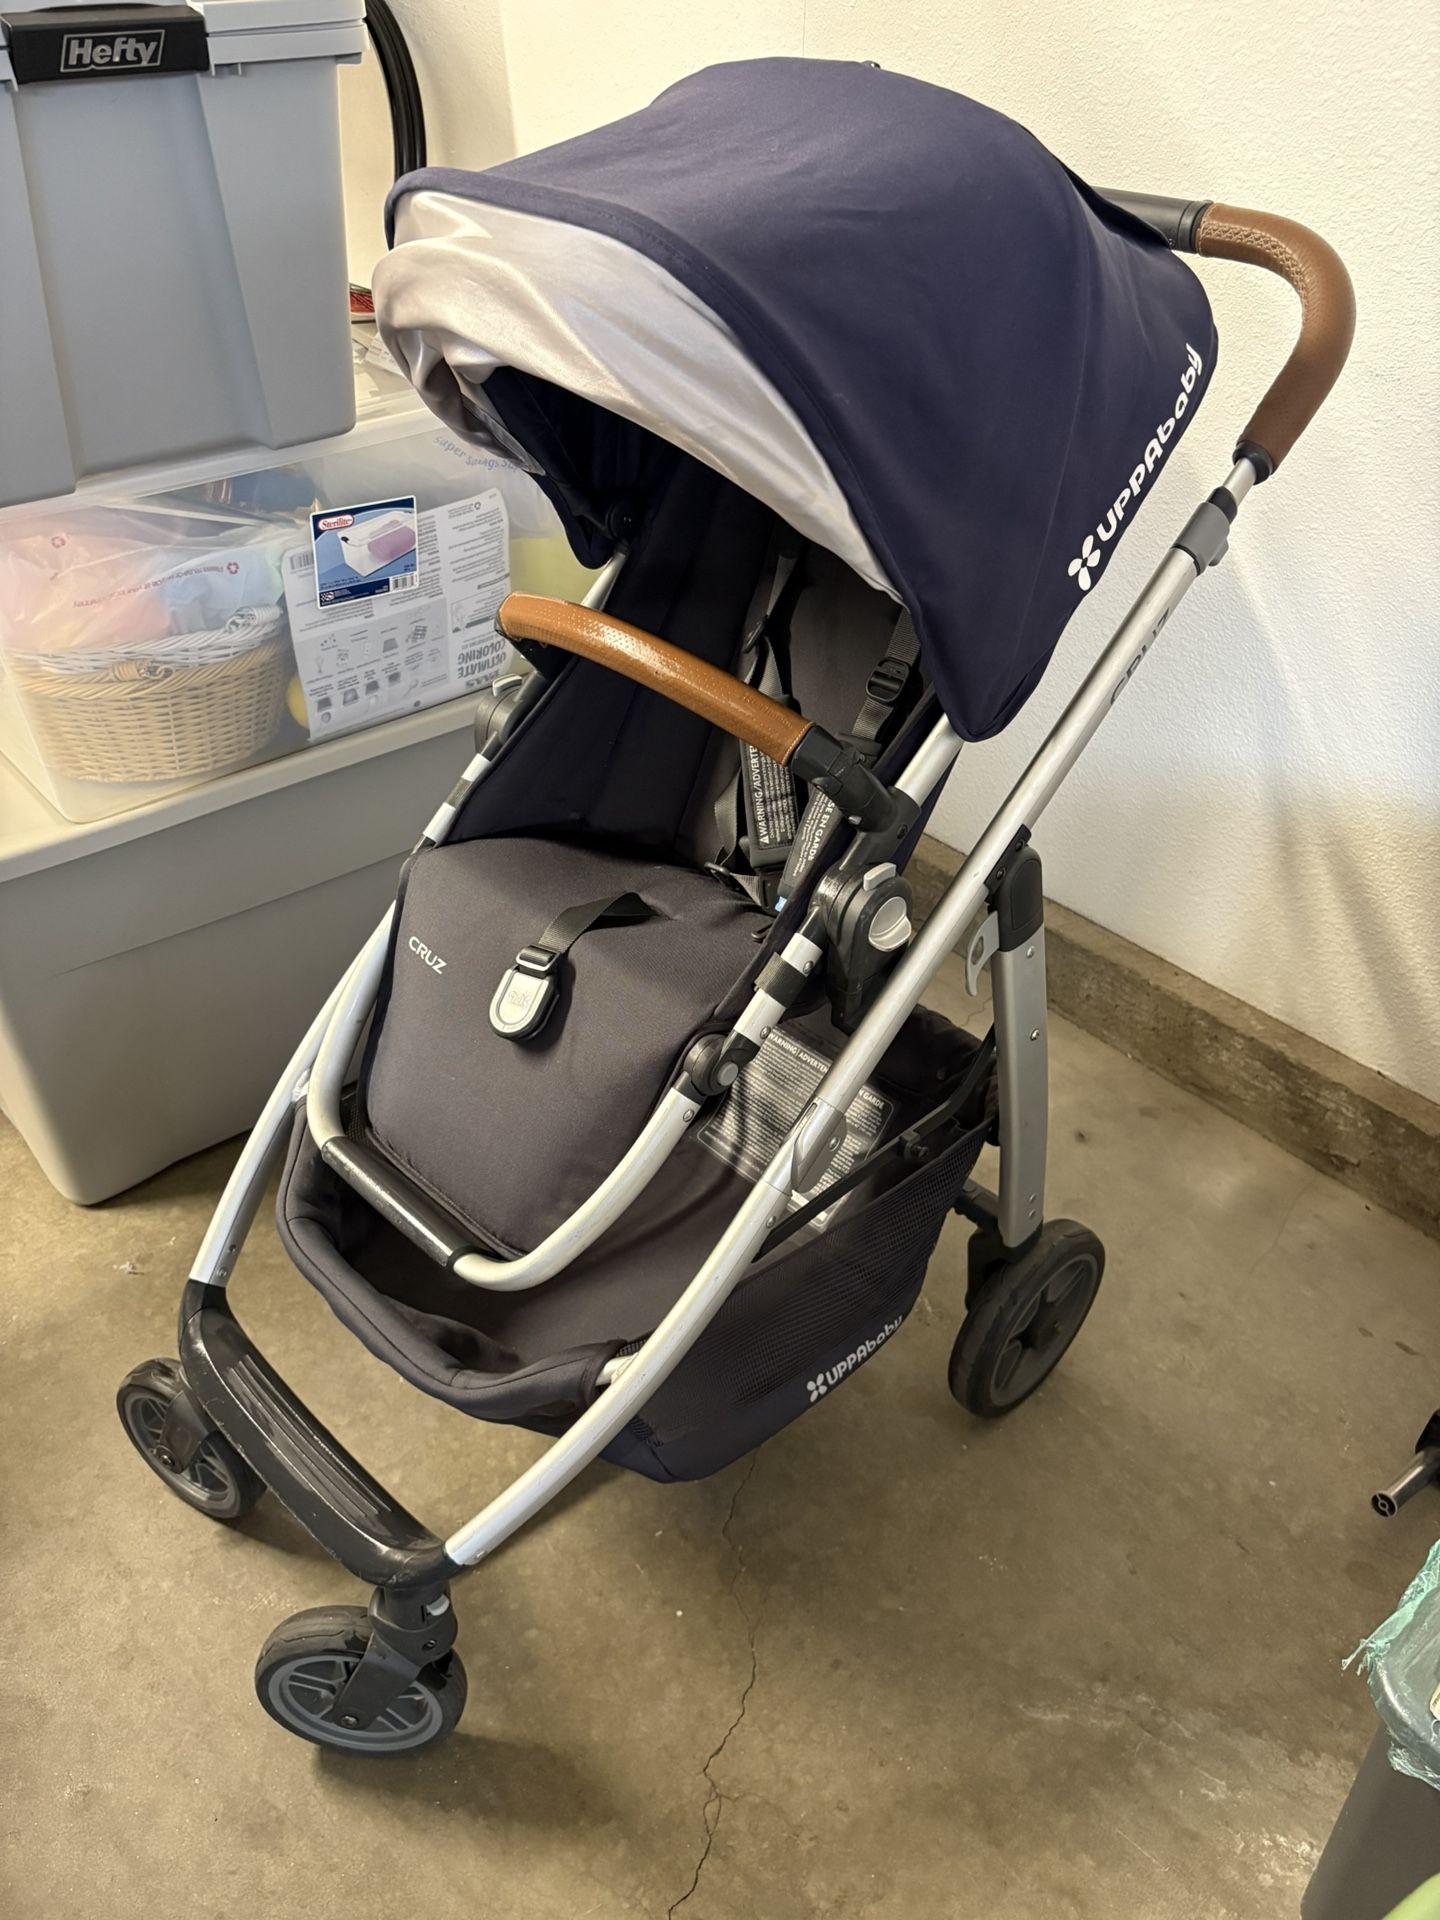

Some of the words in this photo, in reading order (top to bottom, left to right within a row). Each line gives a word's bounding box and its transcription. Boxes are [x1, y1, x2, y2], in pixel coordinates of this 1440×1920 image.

[67, 36, 159, 66] Hefty
[1096, 342, 1203, 543] UPPAbaby
[322, 517, 352, 531] Sterilite
[456, 651, 507, 680] ULTIMATE
[457, 637, 506, 666] COLORING
[819, 814, 831, 829] EN
[808, 829, 824, 862] GARDE
[408, 935, 448, 975] CRUZ
